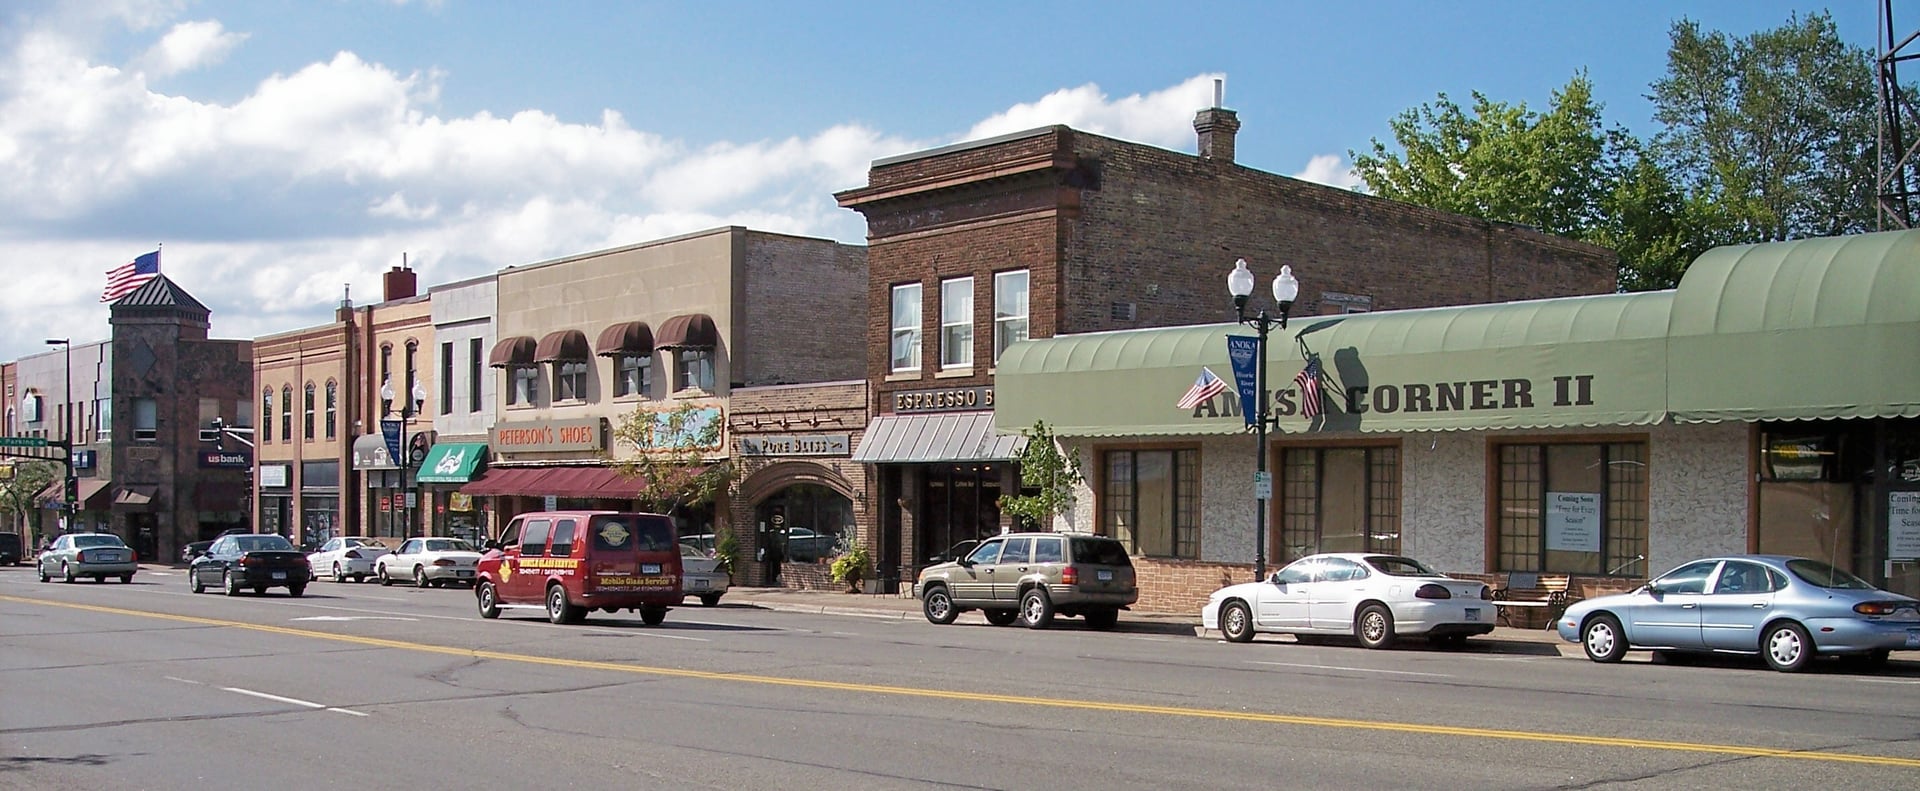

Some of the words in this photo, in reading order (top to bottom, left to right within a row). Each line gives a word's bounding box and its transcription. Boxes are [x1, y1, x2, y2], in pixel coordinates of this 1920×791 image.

[1230, 340, 1256, 349] ANOKA
[1193, 389, 1327, 418] AMS
[1346, 378, 1534, 413] CORNER
[1553, 374, 1594, 406] II
[1243, 388, 1254, 396] City
[896, 389, 977, 409] ESPRESSO
[499, 425, 553, 445] PETERSON'S
[560, 426, 593, 444] SHOES
[5, 439, 35, 447] Parking
[1557, 494, 1579, 503] Coming
[1580, 495, 1594, 503] Soon
[601, 577, 624, 585] Mobile
[626, 577, 644, 585] Glass
[645, 577, 669, 585] Service
